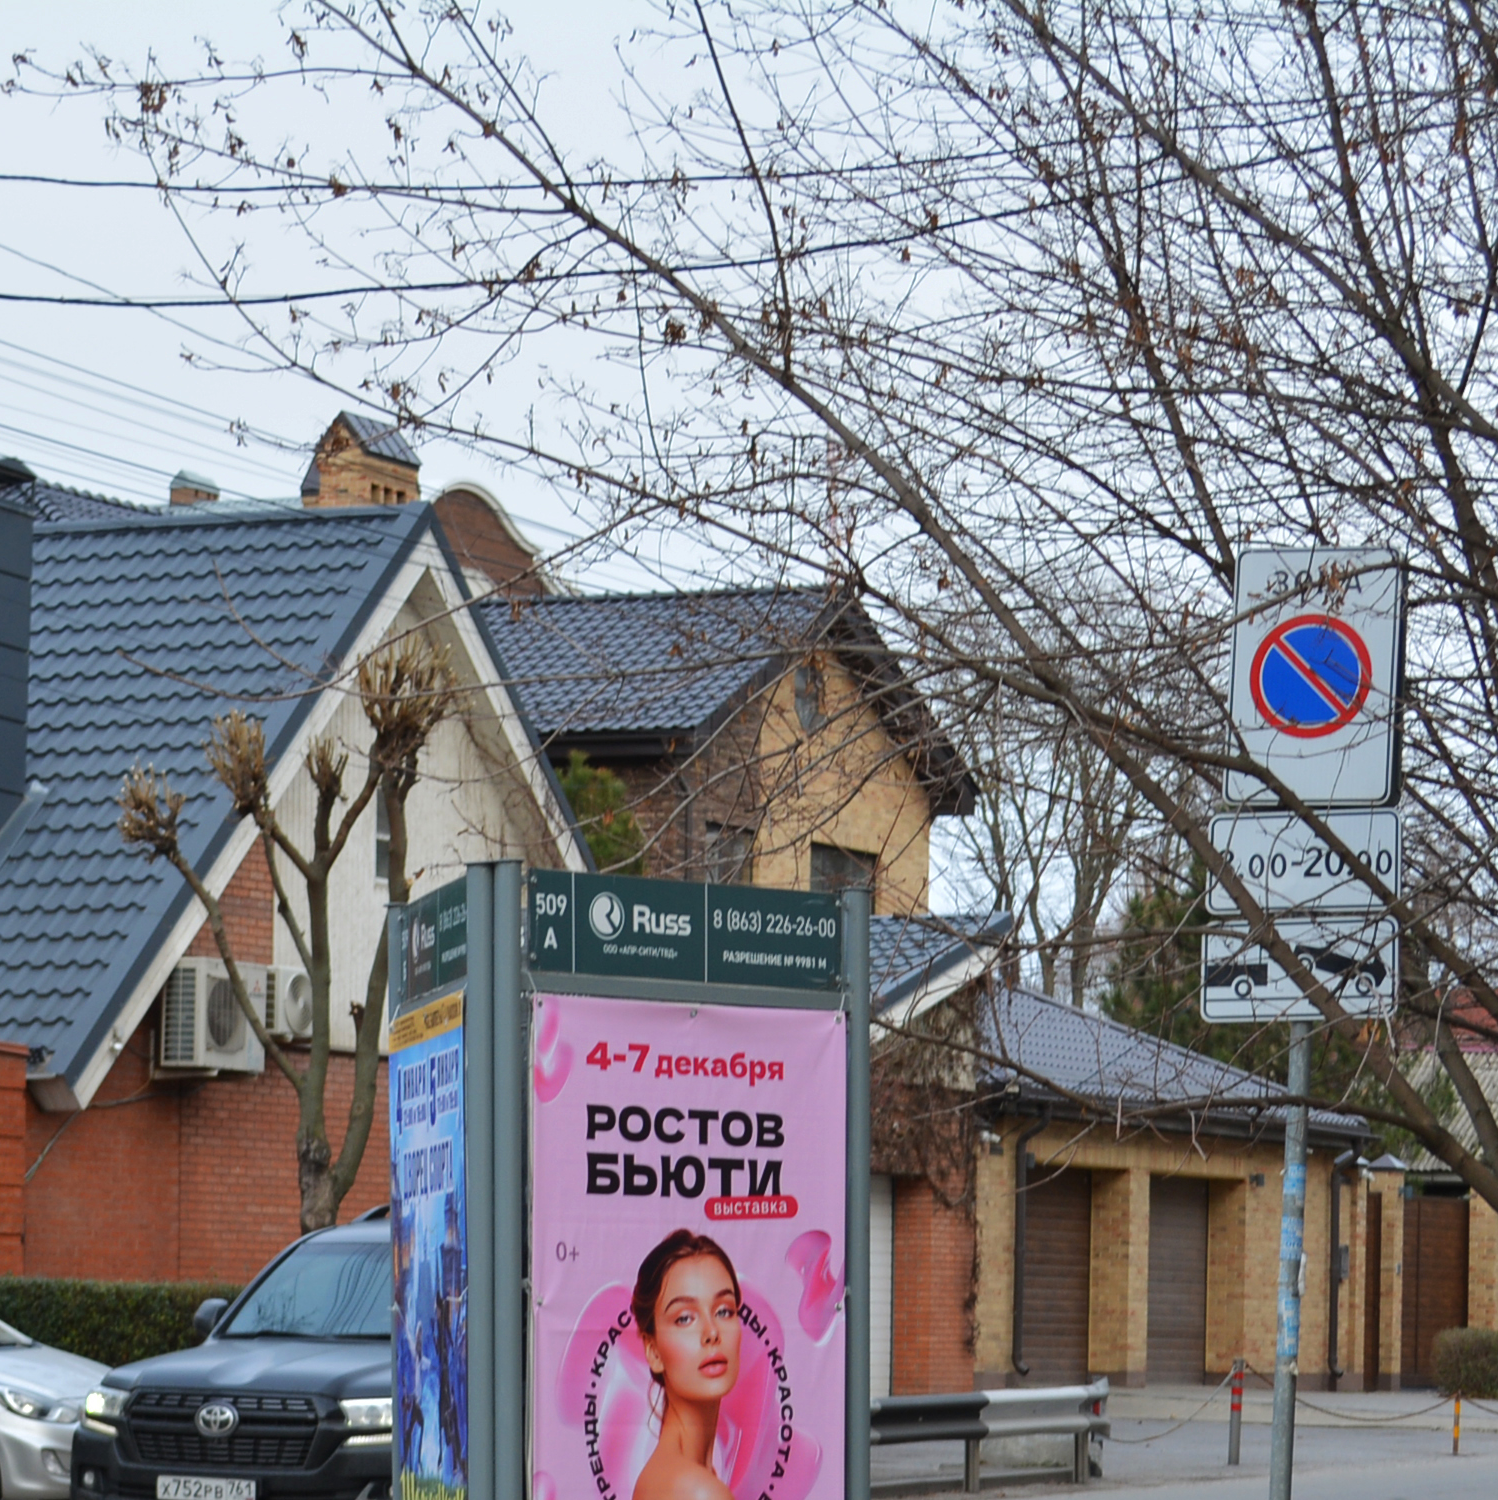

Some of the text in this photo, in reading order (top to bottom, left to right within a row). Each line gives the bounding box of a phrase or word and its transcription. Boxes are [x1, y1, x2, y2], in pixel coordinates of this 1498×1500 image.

[1272, 570, 1362, 596] ЗОА
[535, 893, 568, 917] 509
[632, 904, 692, 937] Russ
[543, 927, 558, 950] А
[713, 907, 836, 939] 8 (863) 226-26-00
[722, 950, 782, 967] РАЗРЕШЕНИЕ
[586, 1041, 784, 1087] 4-7 декабря
[429, 1055, 437, 1128] 5
[586, 1104, 785, 1148] РОСТОВ
[586, 1152, 783, 1199] БЬЮТИ
[713, 1199, 788, 1216] выставка
[556, 1241, 580, 1262] 0+
[590, 1306, 633, 1378] КРАС
[767, 1346, 795, 1481] КРАСОТА
